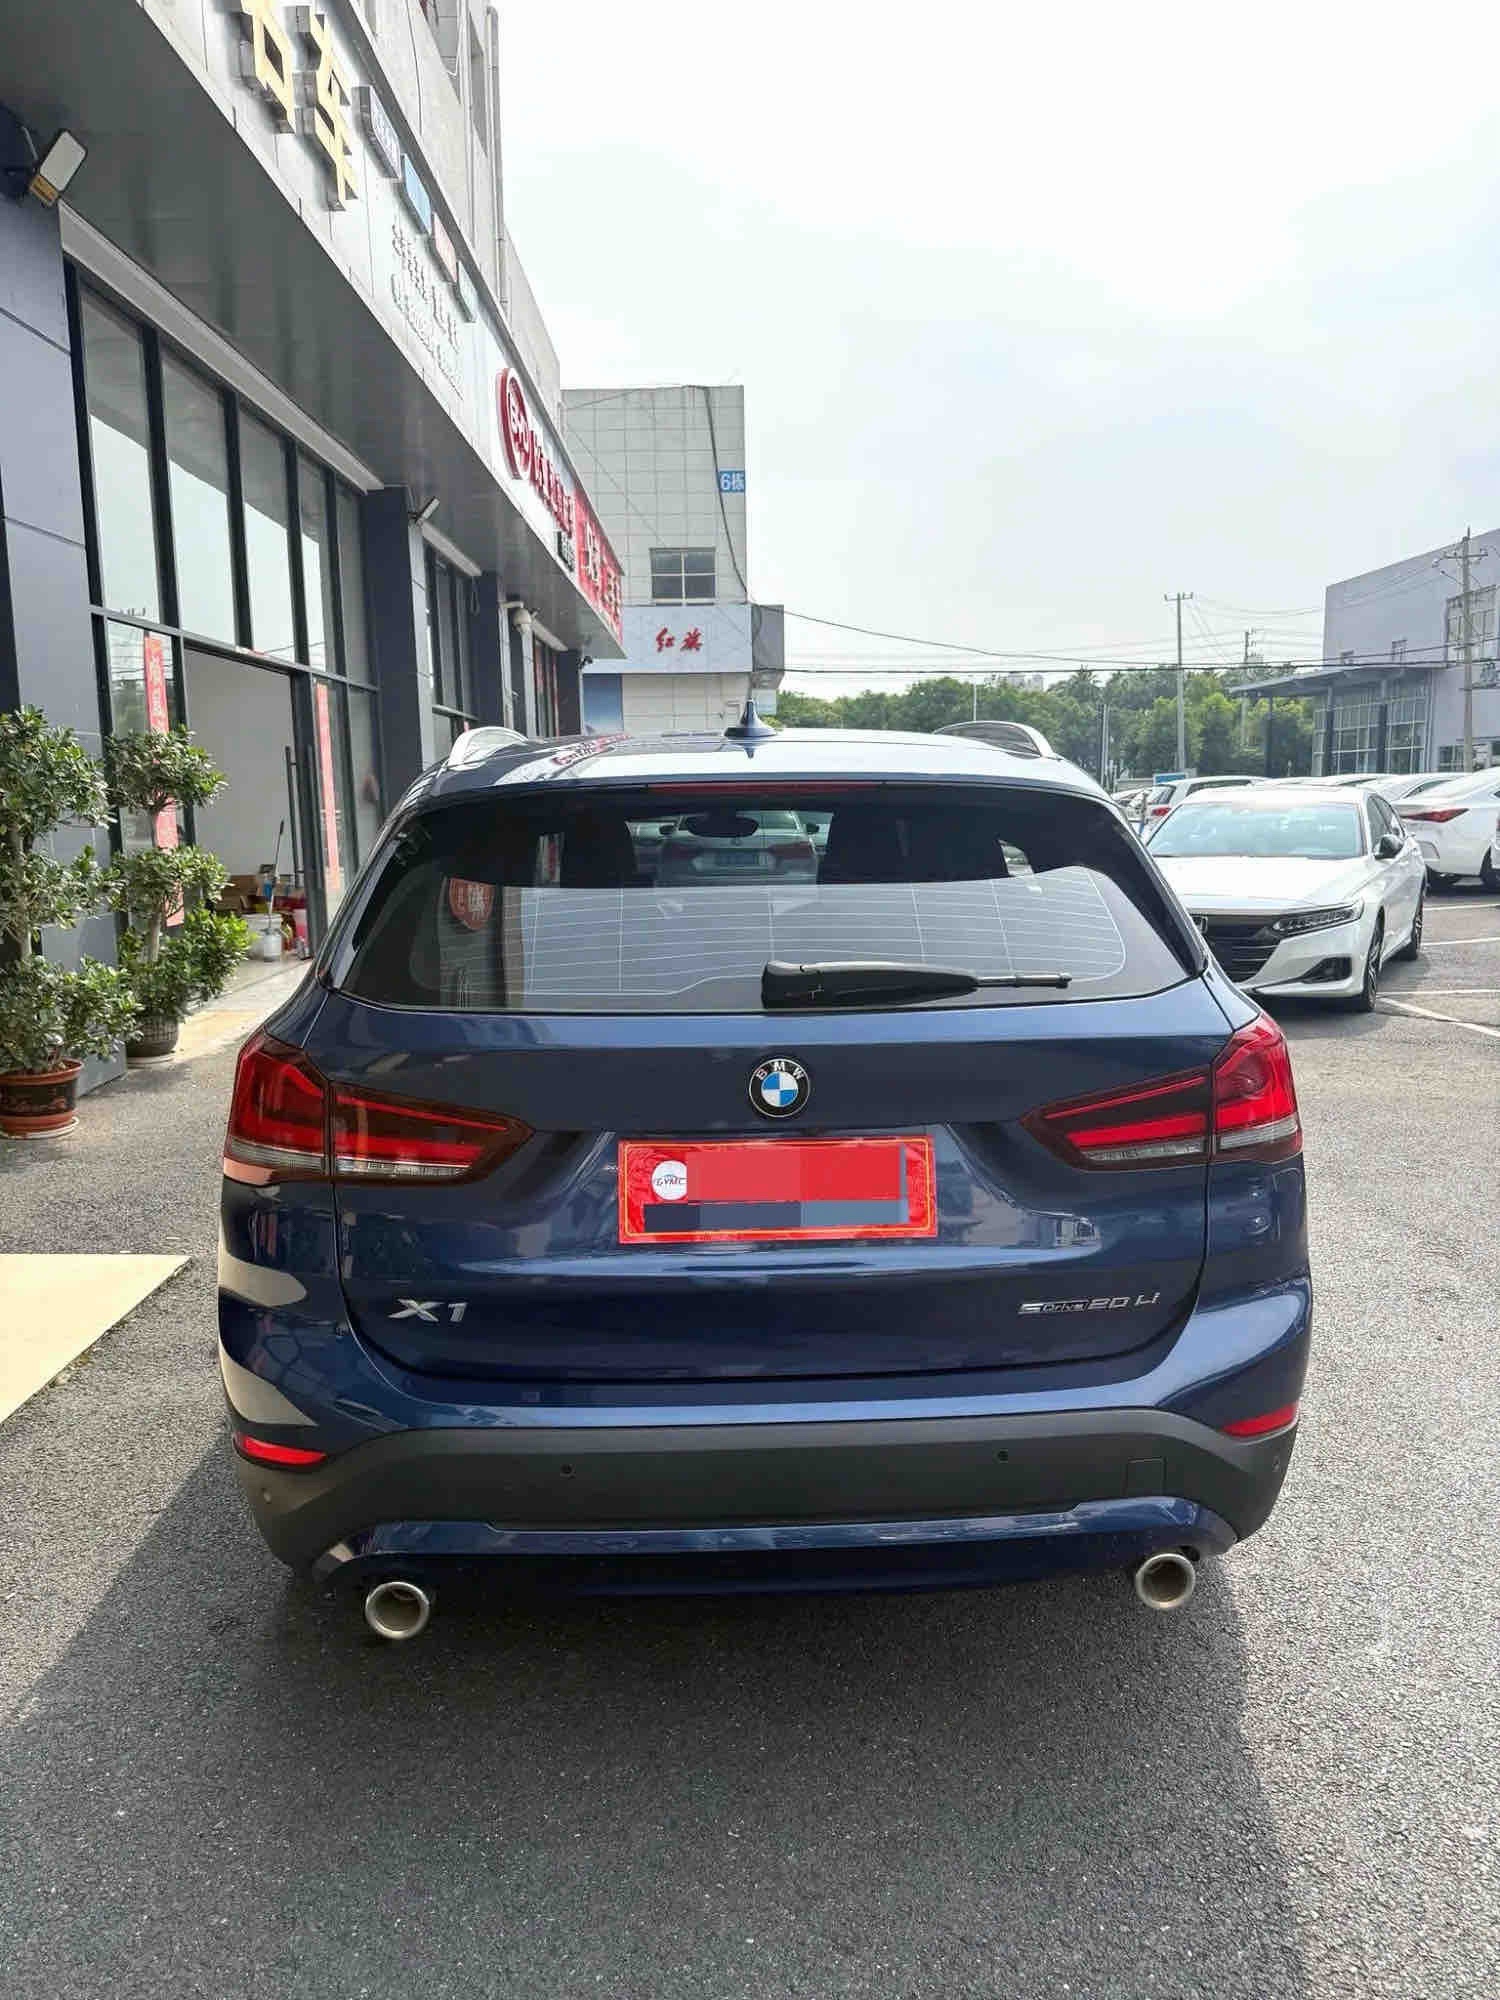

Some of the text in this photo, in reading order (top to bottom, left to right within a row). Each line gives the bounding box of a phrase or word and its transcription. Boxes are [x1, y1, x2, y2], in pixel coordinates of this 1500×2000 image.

[656, 627, 703, 652] 红旗
[755, 1061, 804, 1080] BMW
[387, 1298, 469, 1322] X1
